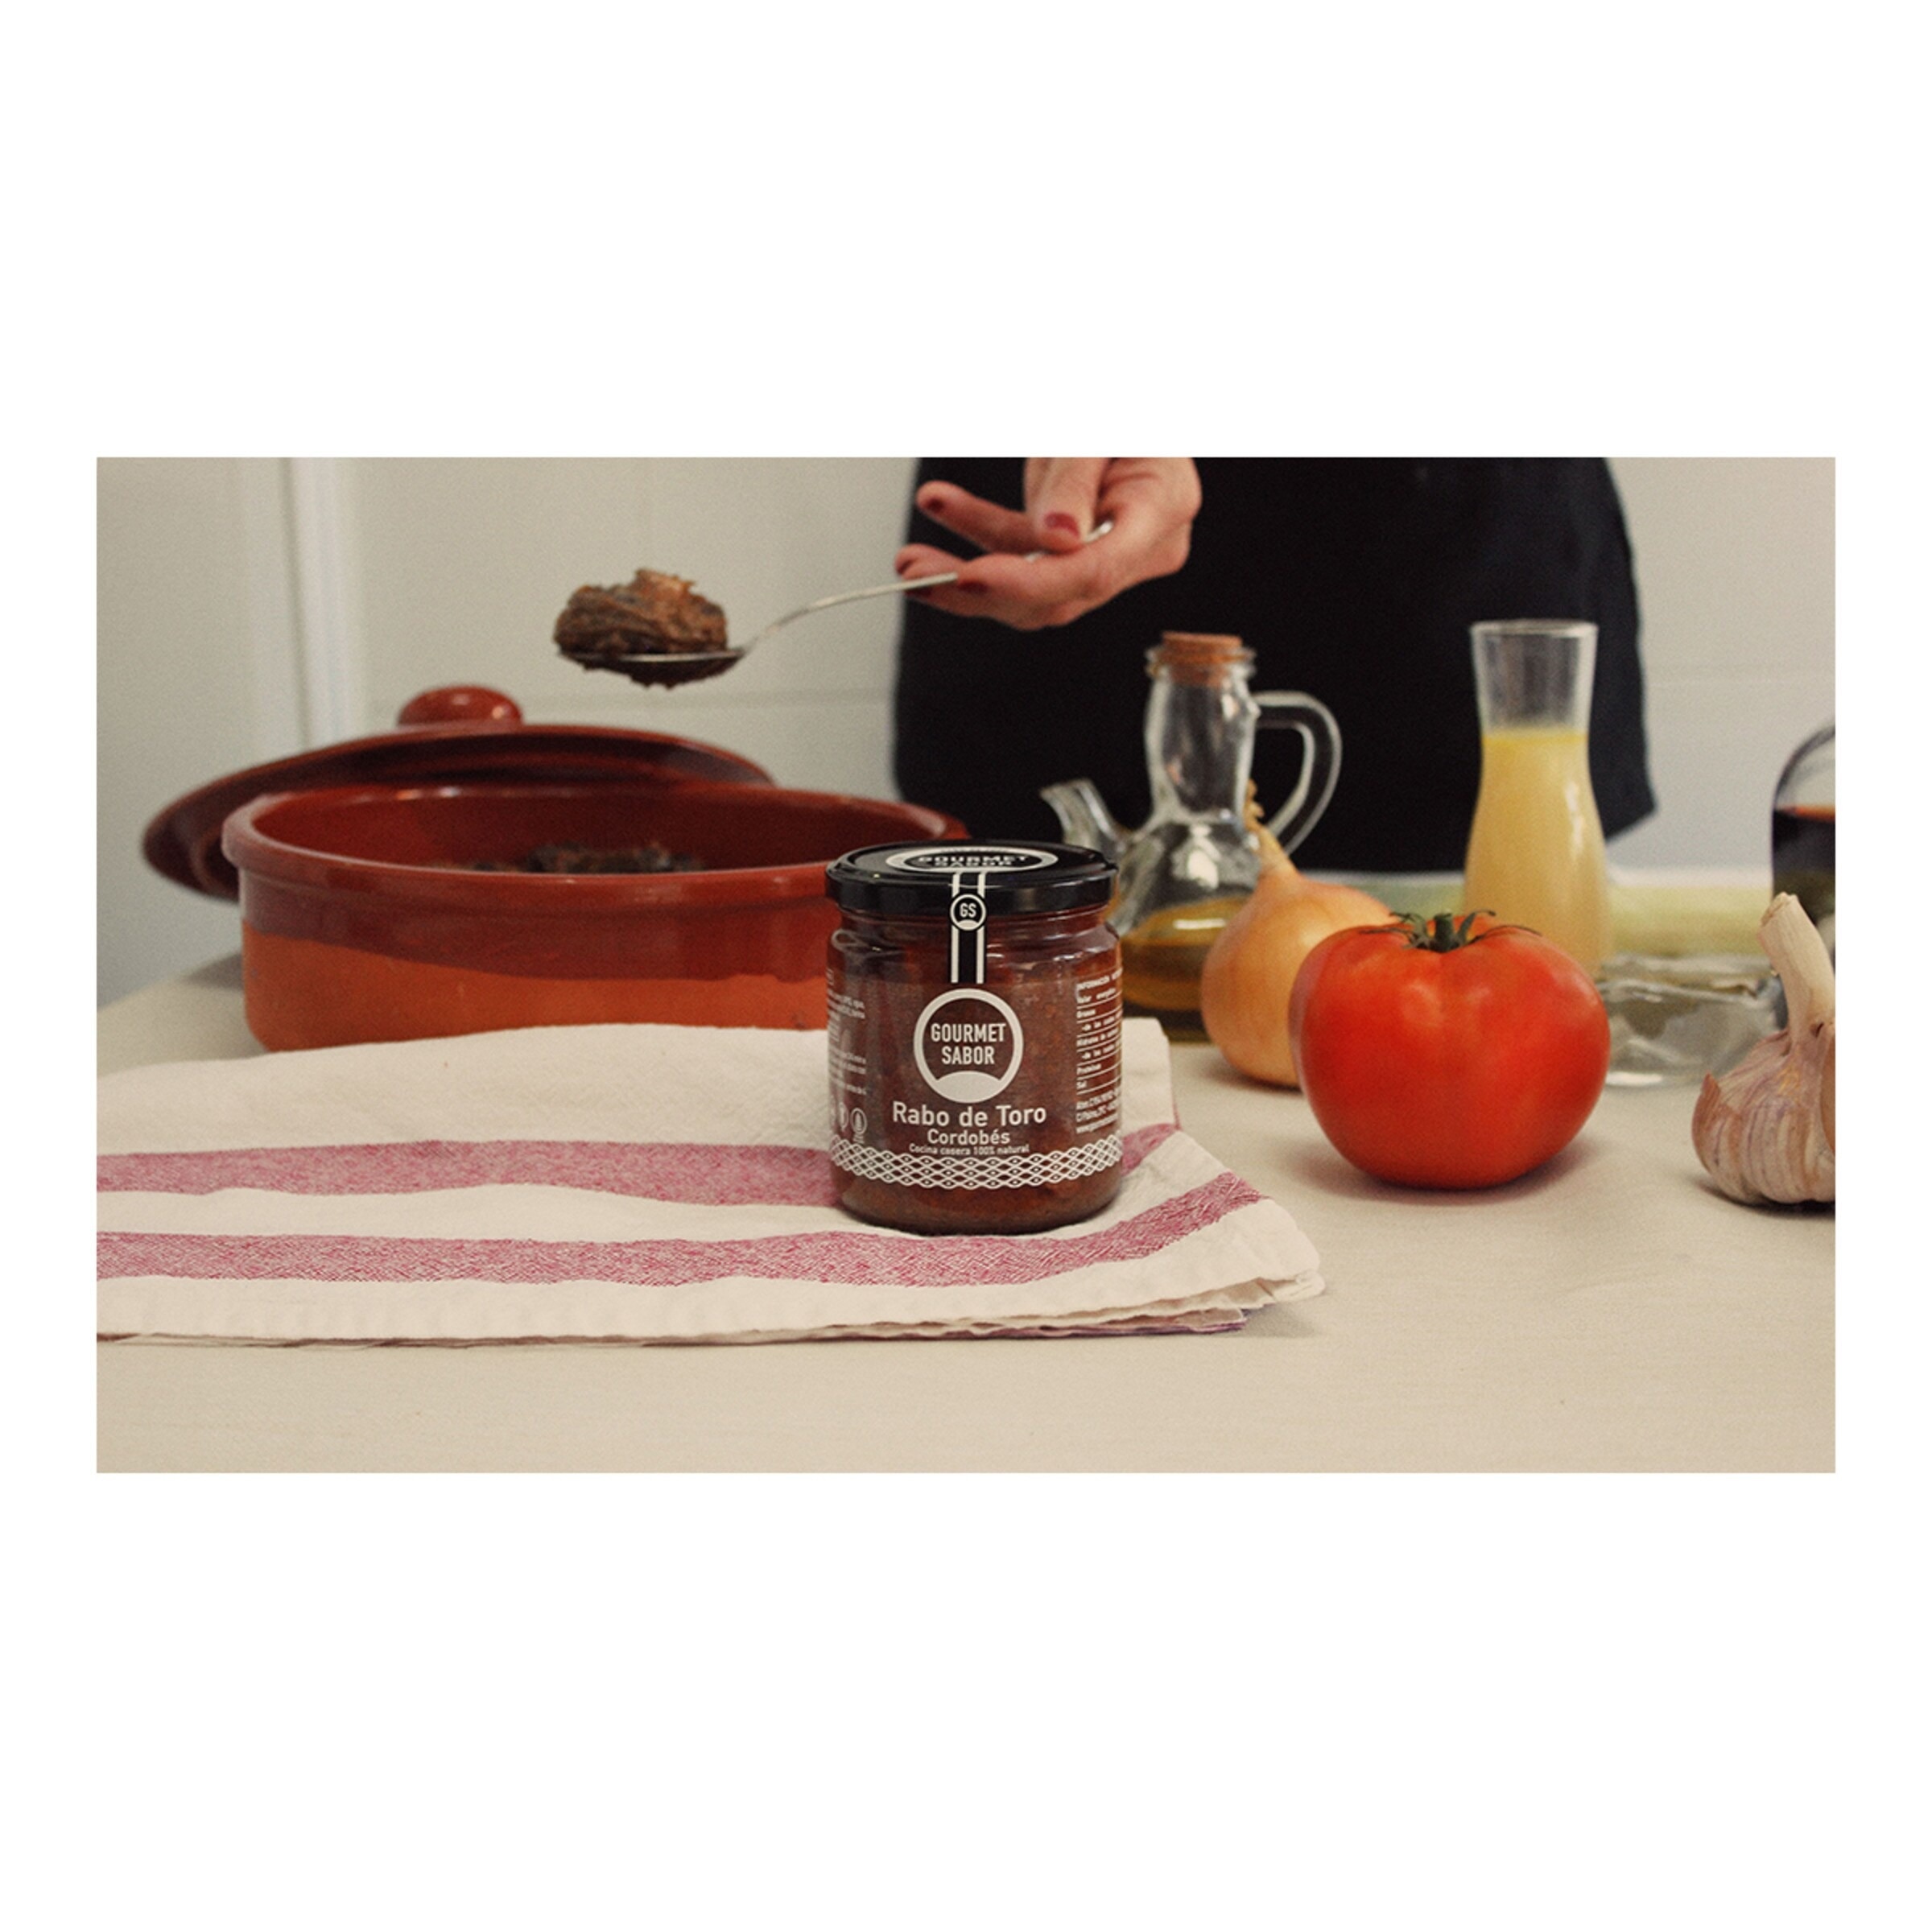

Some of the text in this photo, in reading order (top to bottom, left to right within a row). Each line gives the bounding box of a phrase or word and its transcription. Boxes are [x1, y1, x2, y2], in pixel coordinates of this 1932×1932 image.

[960, 902, 976, 918] GS
[931, 1022, 1006, 1042] GOURMET
[941, 1046, 995, 1065] SABOR
[893, 1101, 1046, 1126] Rabo de Toro
[927, 1129, 1010, 1145] Cordobés
[909, 1143, 1030, 1155] Cocina casera 100% natural
